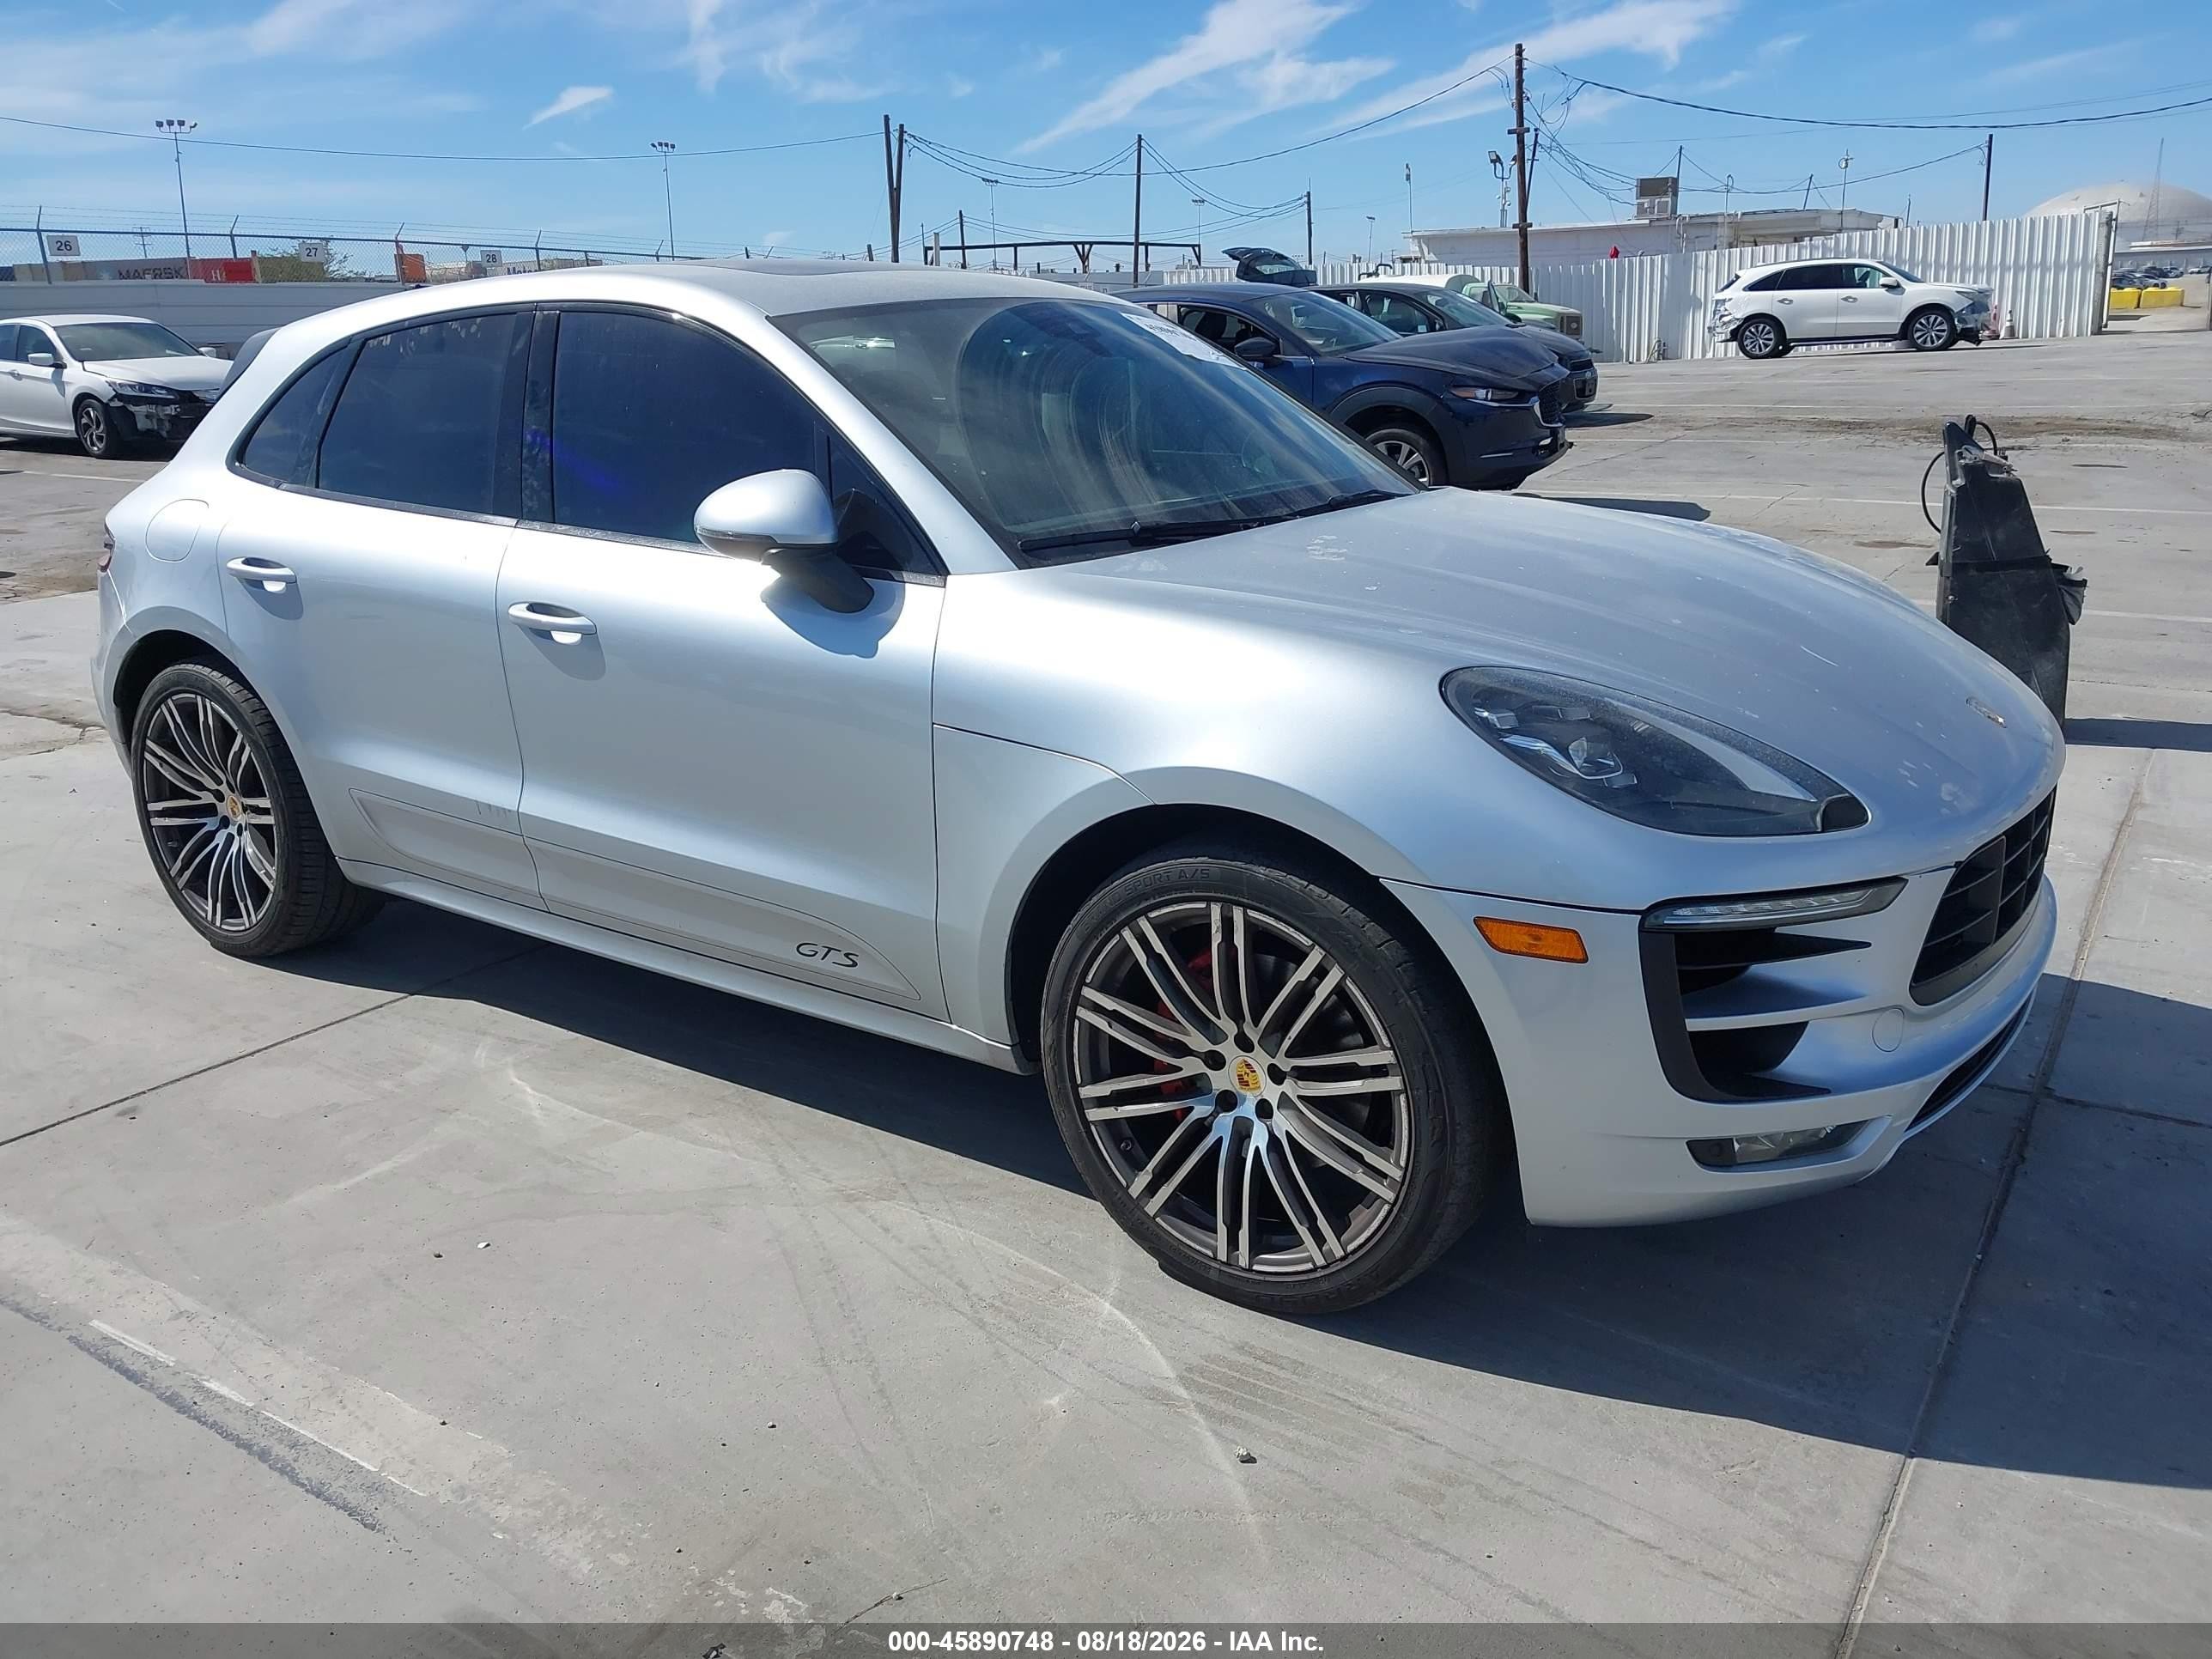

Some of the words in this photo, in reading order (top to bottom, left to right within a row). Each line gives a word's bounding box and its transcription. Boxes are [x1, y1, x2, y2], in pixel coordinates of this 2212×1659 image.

[55, 240, 72, 252] 26
[305, 246, 319, 258] 27
[486, 253, 497, 264] 28
[1124, 870, 1171, 897] SPORT
[1178, 867, 1210, 880] A/S
[796, 942, 860, 968] GTS
